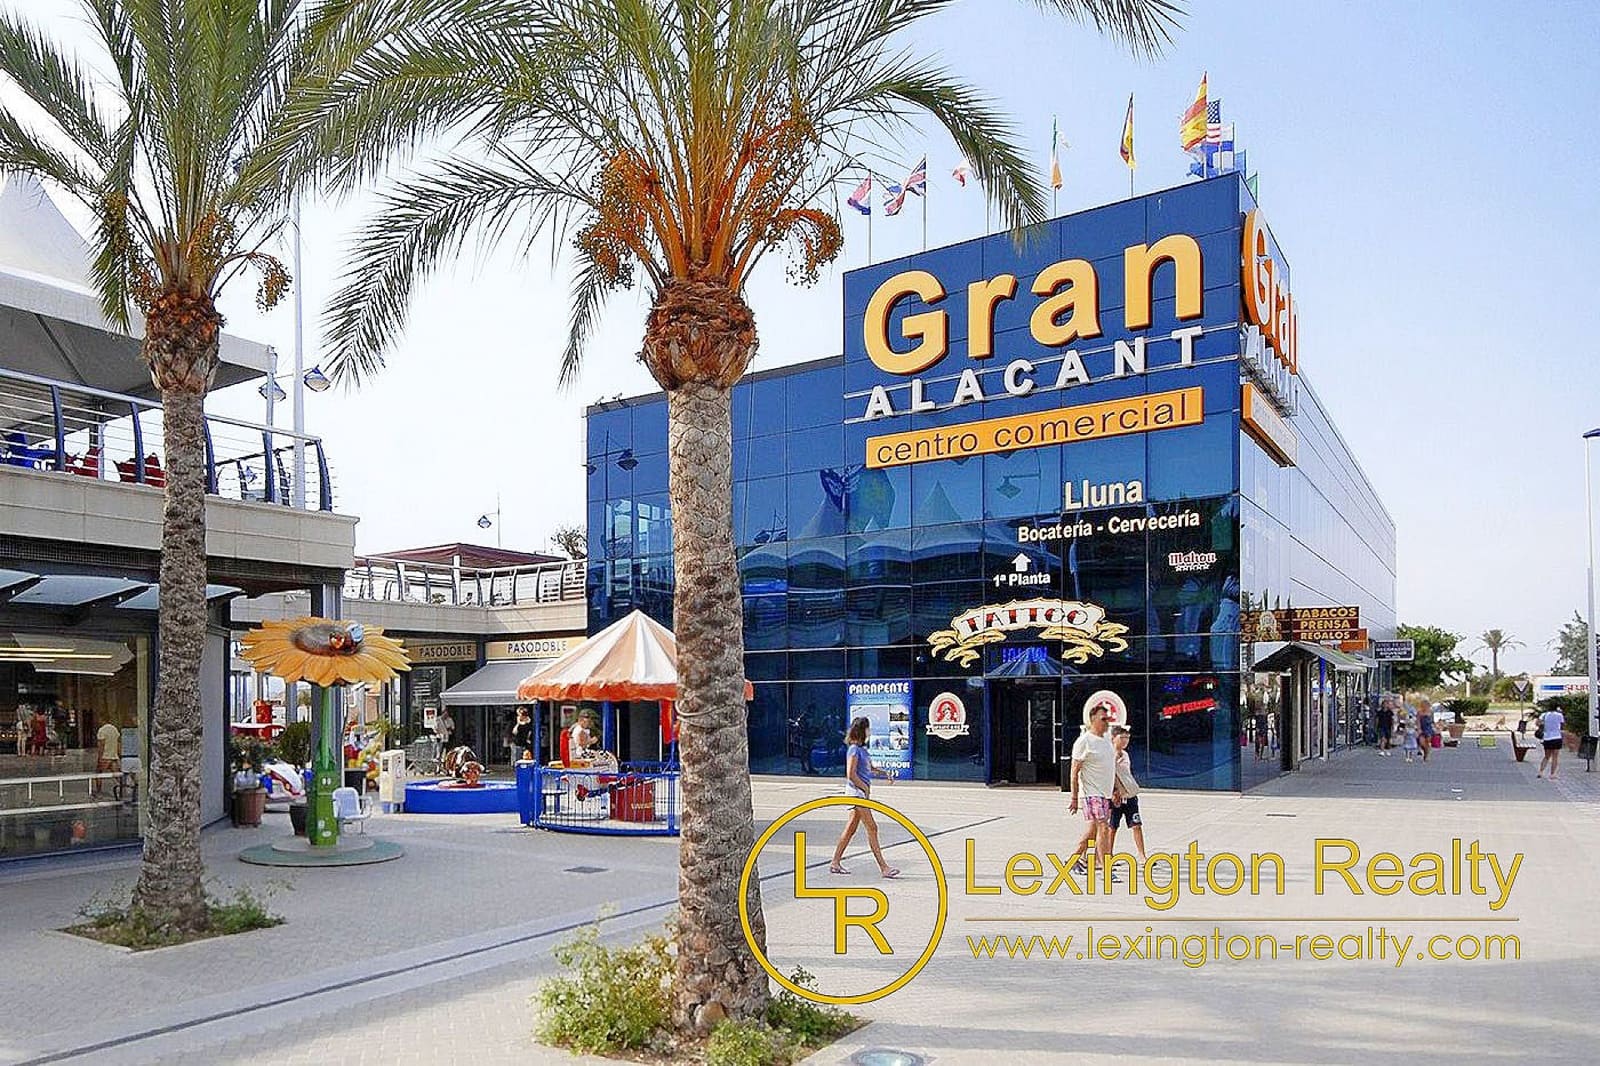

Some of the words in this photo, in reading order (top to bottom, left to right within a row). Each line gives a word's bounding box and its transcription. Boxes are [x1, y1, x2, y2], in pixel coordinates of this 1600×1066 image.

[1246, 208, 1299, 375] Gran
[863, 233, 1204, 375] Gran
[864, 325, 1205, 419] ALACANT
[876, 432, 978, 464] centro
[993, 392, 1186, 448] comercial
[1064, 479, 1143, 510] Lluna
[1018, 519, 1092, 543] Bocatería
[1108, 508, 1200, 535] Cervecería
[1168, 551, 1217, 567] Mahou
[1008, 571, 1051, 587] Planta
[960, 606, 1089, 633] TATTOO
[1295, 607, 1357, 618] TABACOS
[1300, 619, 1350, 630] PRENSA
[1300, 631, 1350, 640] REGALOS
[420, 645, 472, 657] PASODOBLE
[507, 640, 567, 654] PASODOBLE
[848, 682, 910, 695] PARAPENTE
